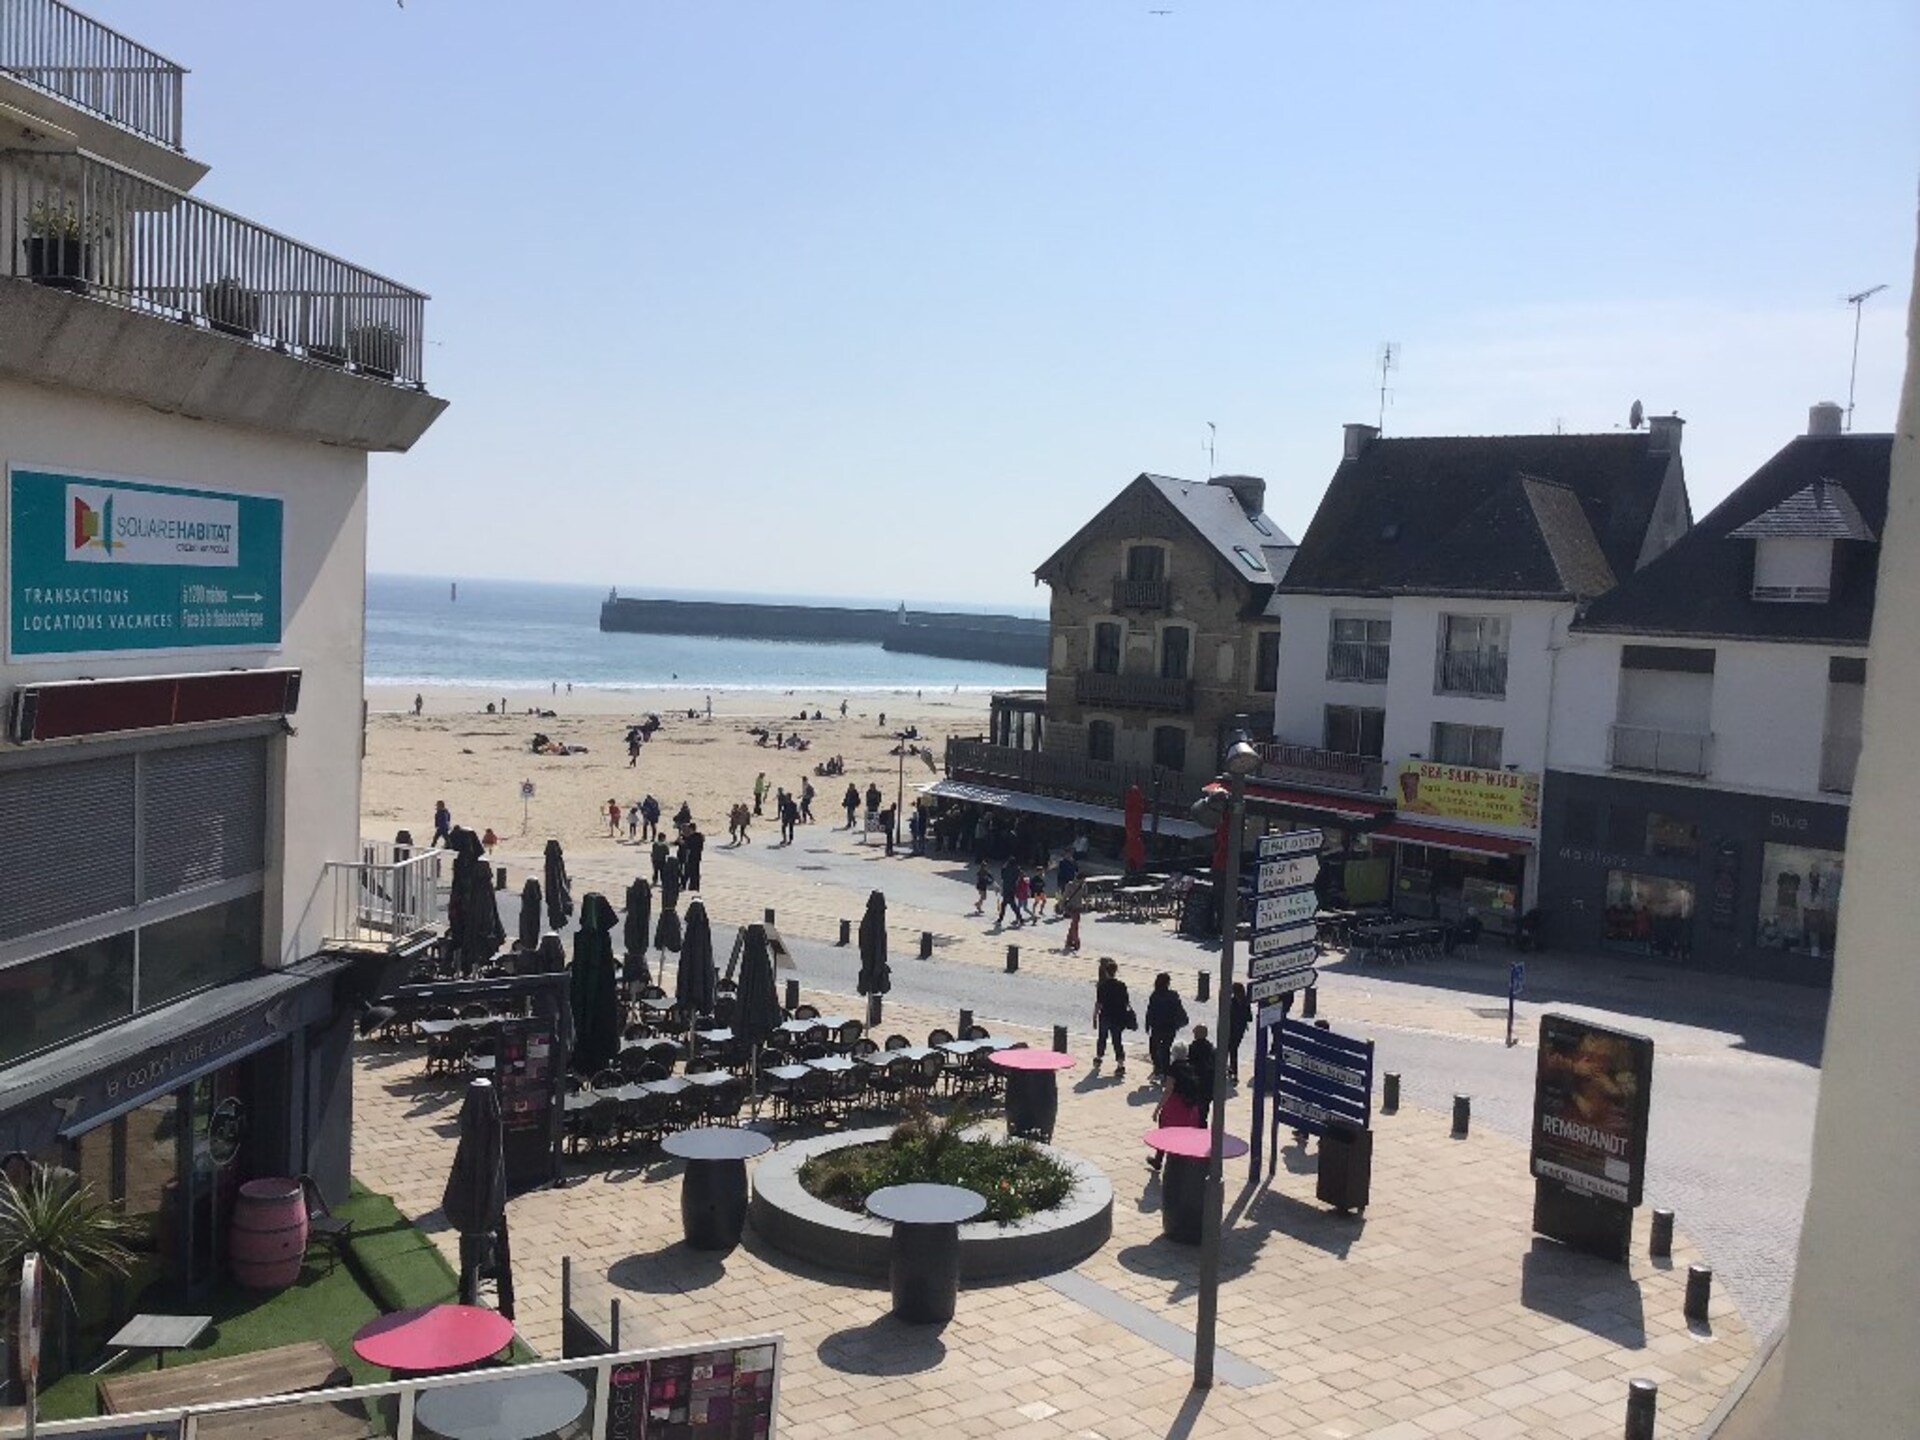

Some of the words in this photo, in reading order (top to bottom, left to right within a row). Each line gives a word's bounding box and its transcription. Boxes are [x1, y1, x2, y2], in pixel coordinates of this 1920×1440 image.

[23, 587, 129, 604] TRANSACTIONS
[23, 614, 103, 632] LOCATIONS
[108, 614, 173, 629] VACANCES
[1542, 1114, 1628, 1156] REMBRANDT
